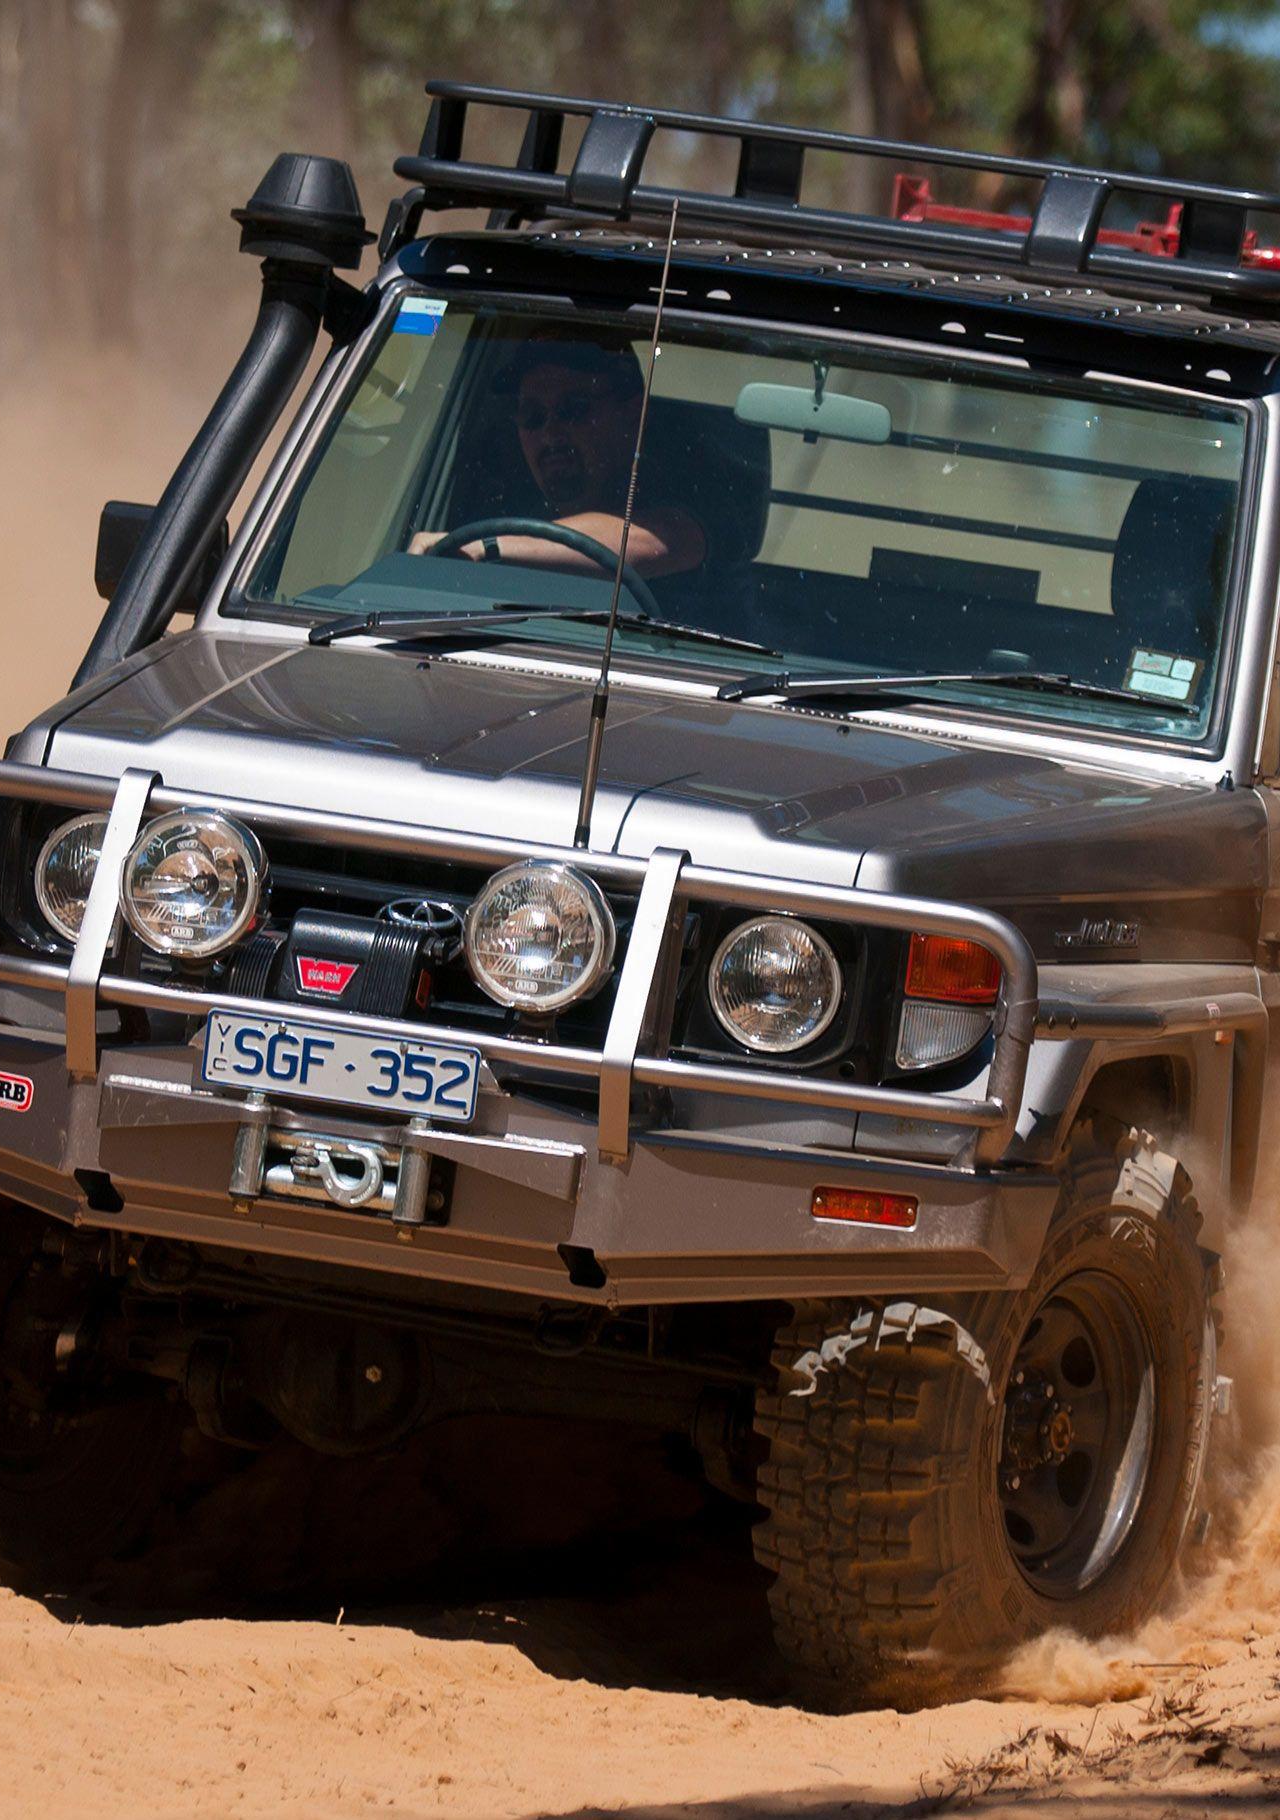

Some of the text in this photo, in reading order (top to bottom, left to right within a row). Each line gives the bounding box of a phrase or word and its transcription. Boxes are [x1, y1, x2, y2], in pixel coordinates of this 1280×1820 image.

[212, 1022, 231, 1071] VIC
[233, 1028, 471, 1109] SGF 352
